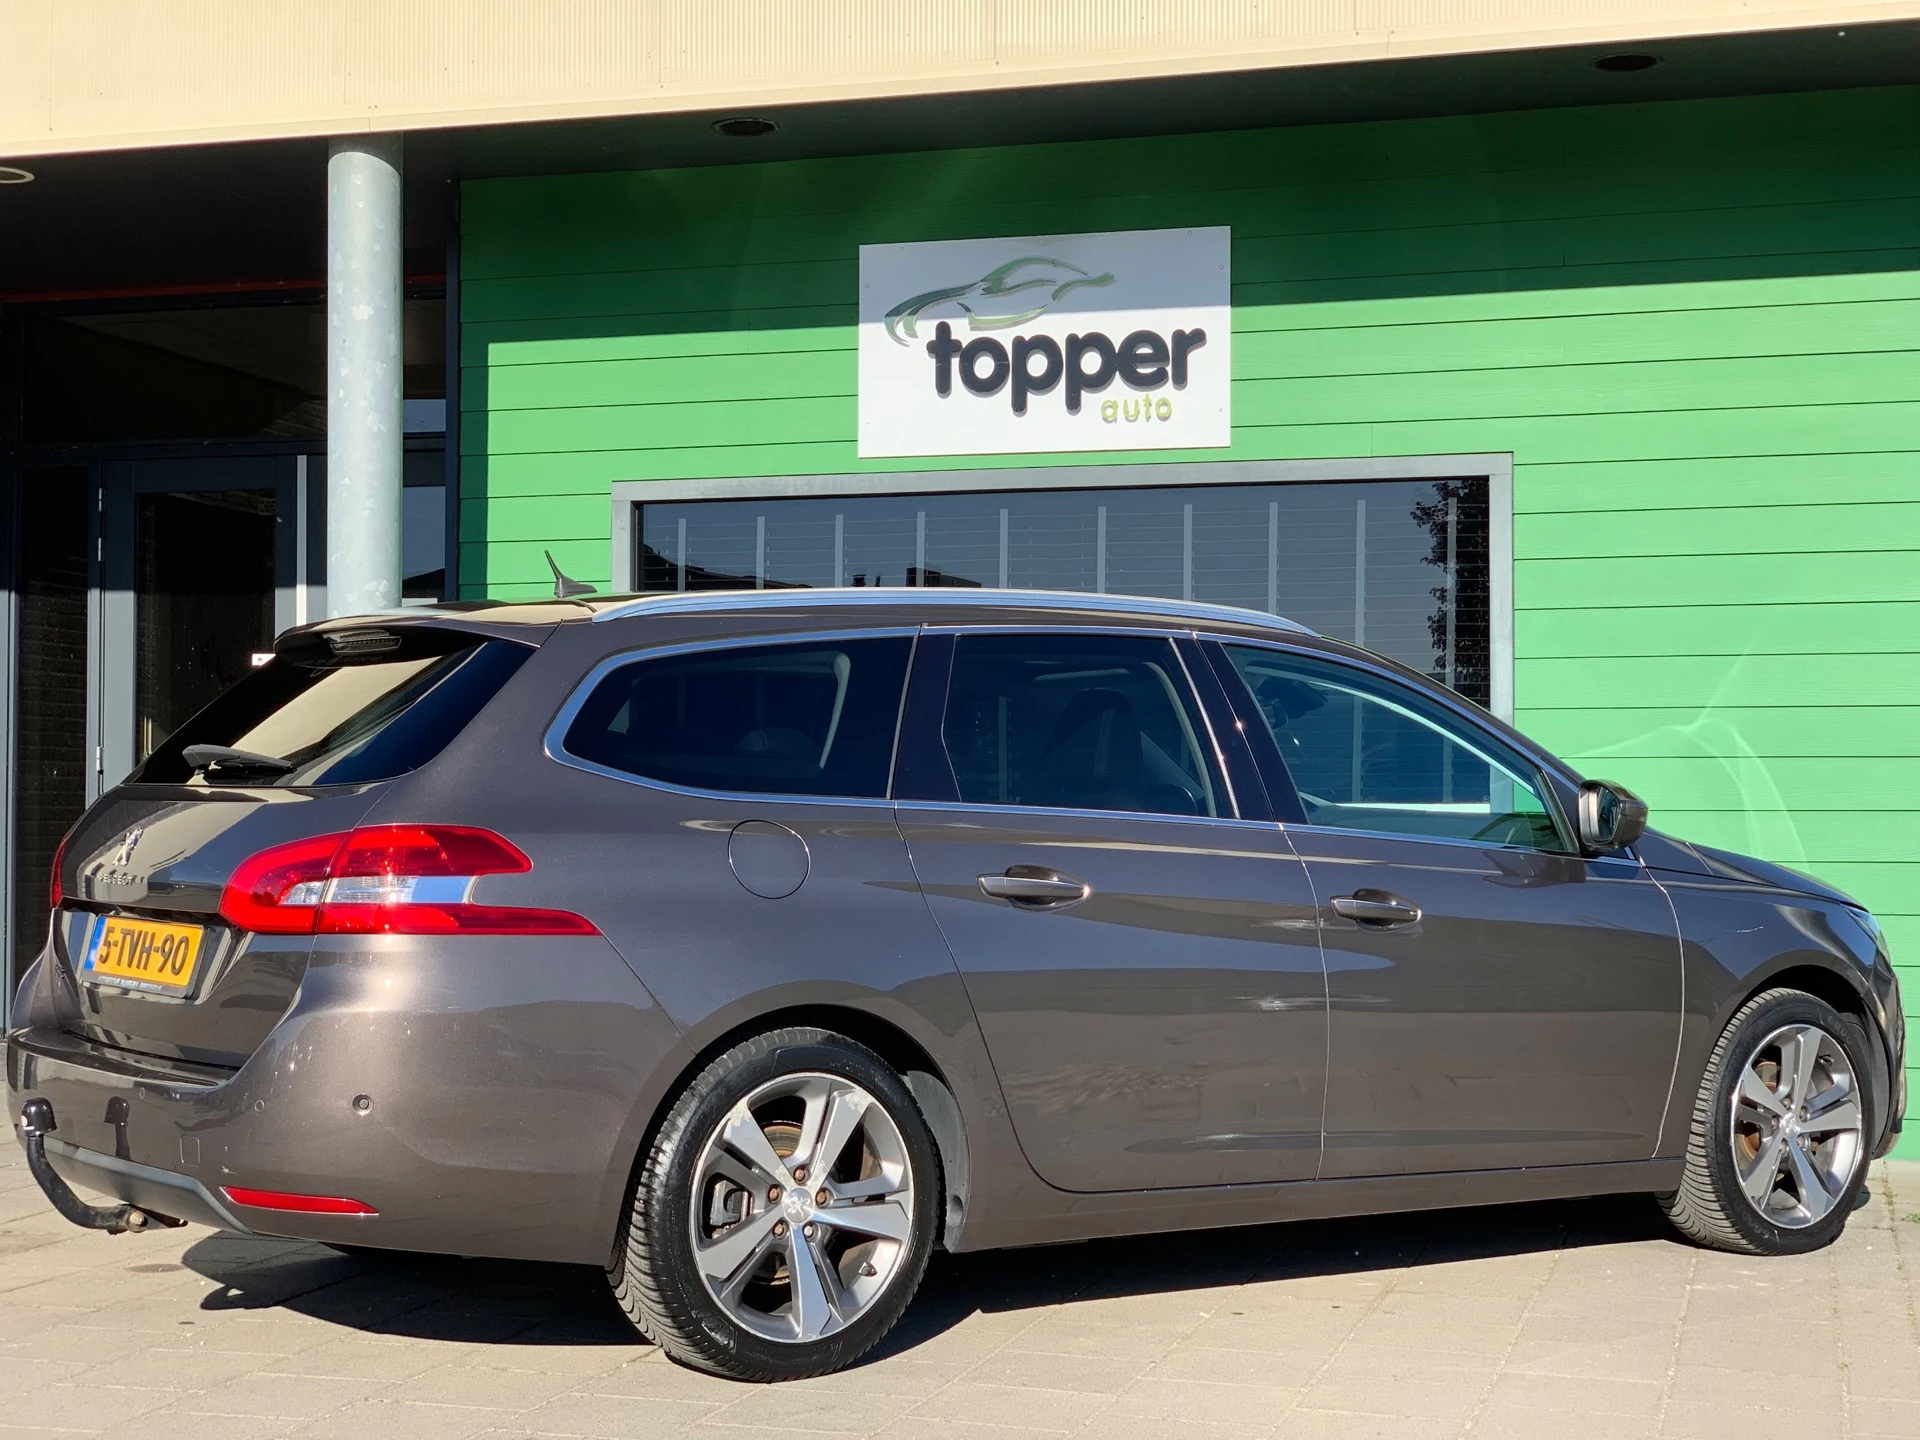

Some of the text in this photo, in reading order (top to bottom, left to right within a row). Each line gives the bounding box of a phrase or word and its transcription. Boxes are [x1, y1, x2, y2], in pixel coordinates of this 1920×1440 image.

[926, 321, 1206, 414] topper
[1101, 394, 1172, 421] auto
[99, 926, 190, 976] 5-TVH-90
